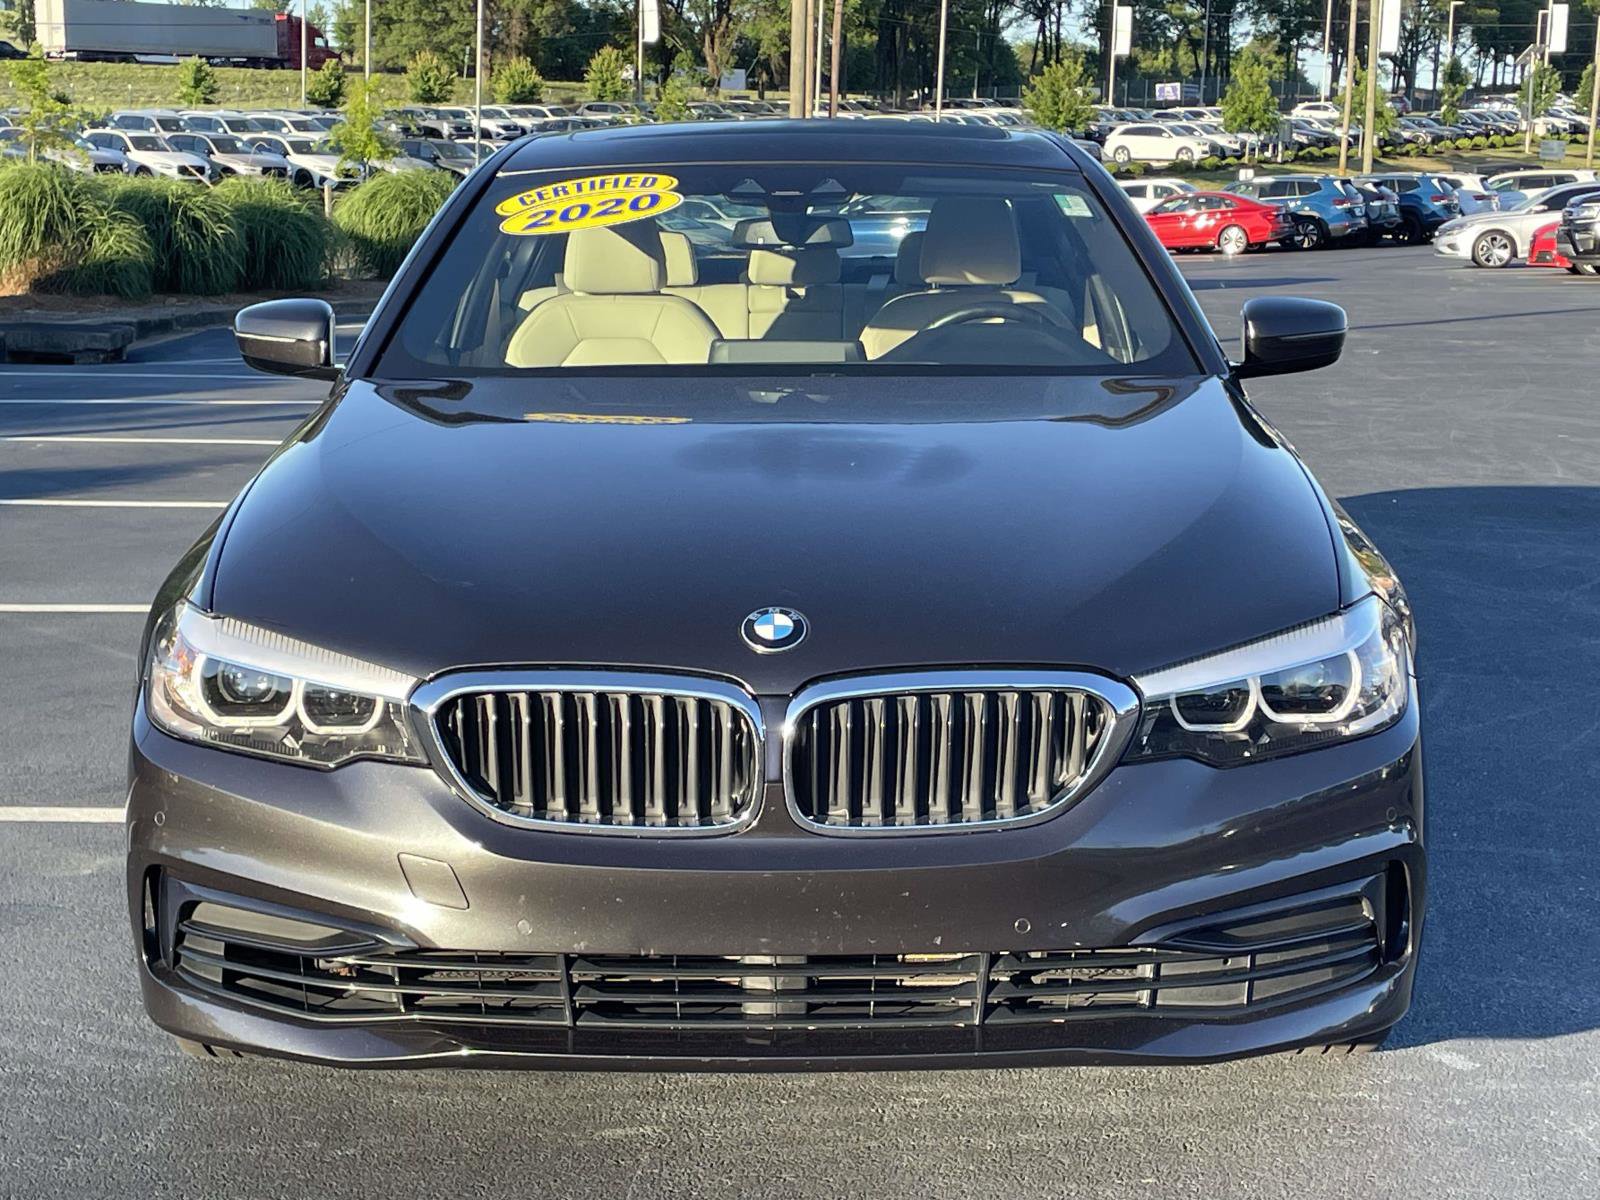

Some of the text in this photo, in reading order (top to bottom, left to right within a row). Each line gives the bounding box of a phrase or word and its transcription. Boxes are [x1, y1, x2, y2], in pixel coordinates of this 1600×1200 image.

[518, 176, 658, 206] CERTIFIED
[521, 193, 661, 231] 2020
[748, 607, 800, 621] BMW
